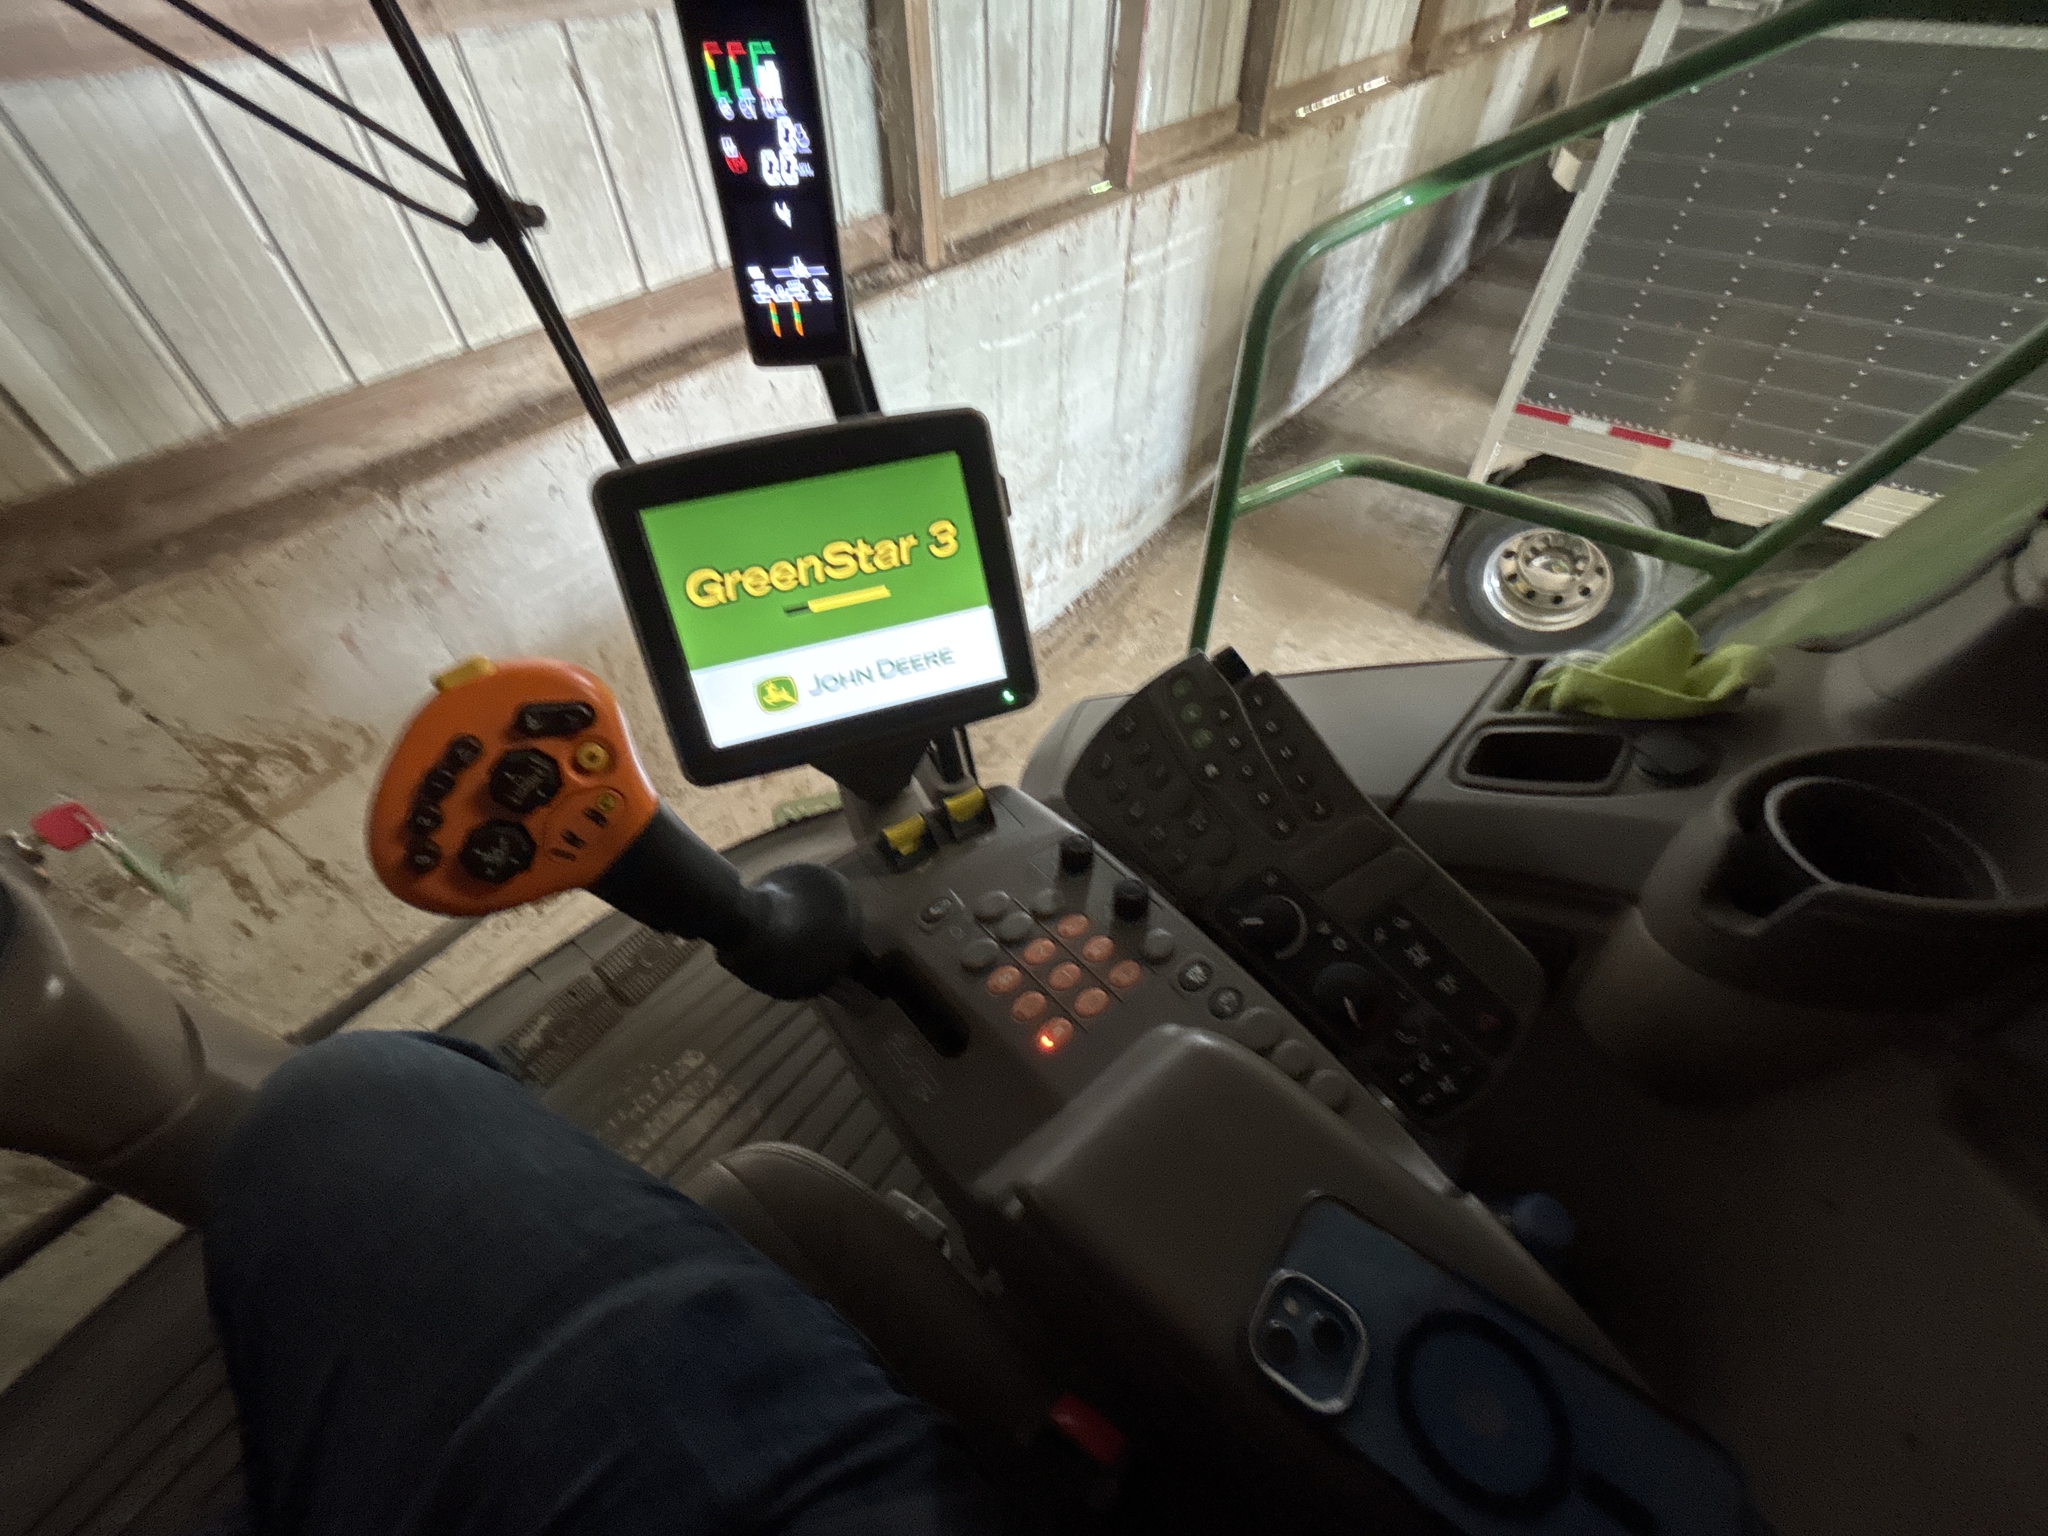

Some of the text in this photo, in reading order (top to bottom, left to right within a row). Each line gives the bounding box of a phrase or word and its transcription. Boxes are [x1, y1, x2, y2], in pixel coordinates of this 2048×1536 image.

[686, 519, 959, 608] GreenStar 3
[808, 647, 956, 697] JOHN DEERE
